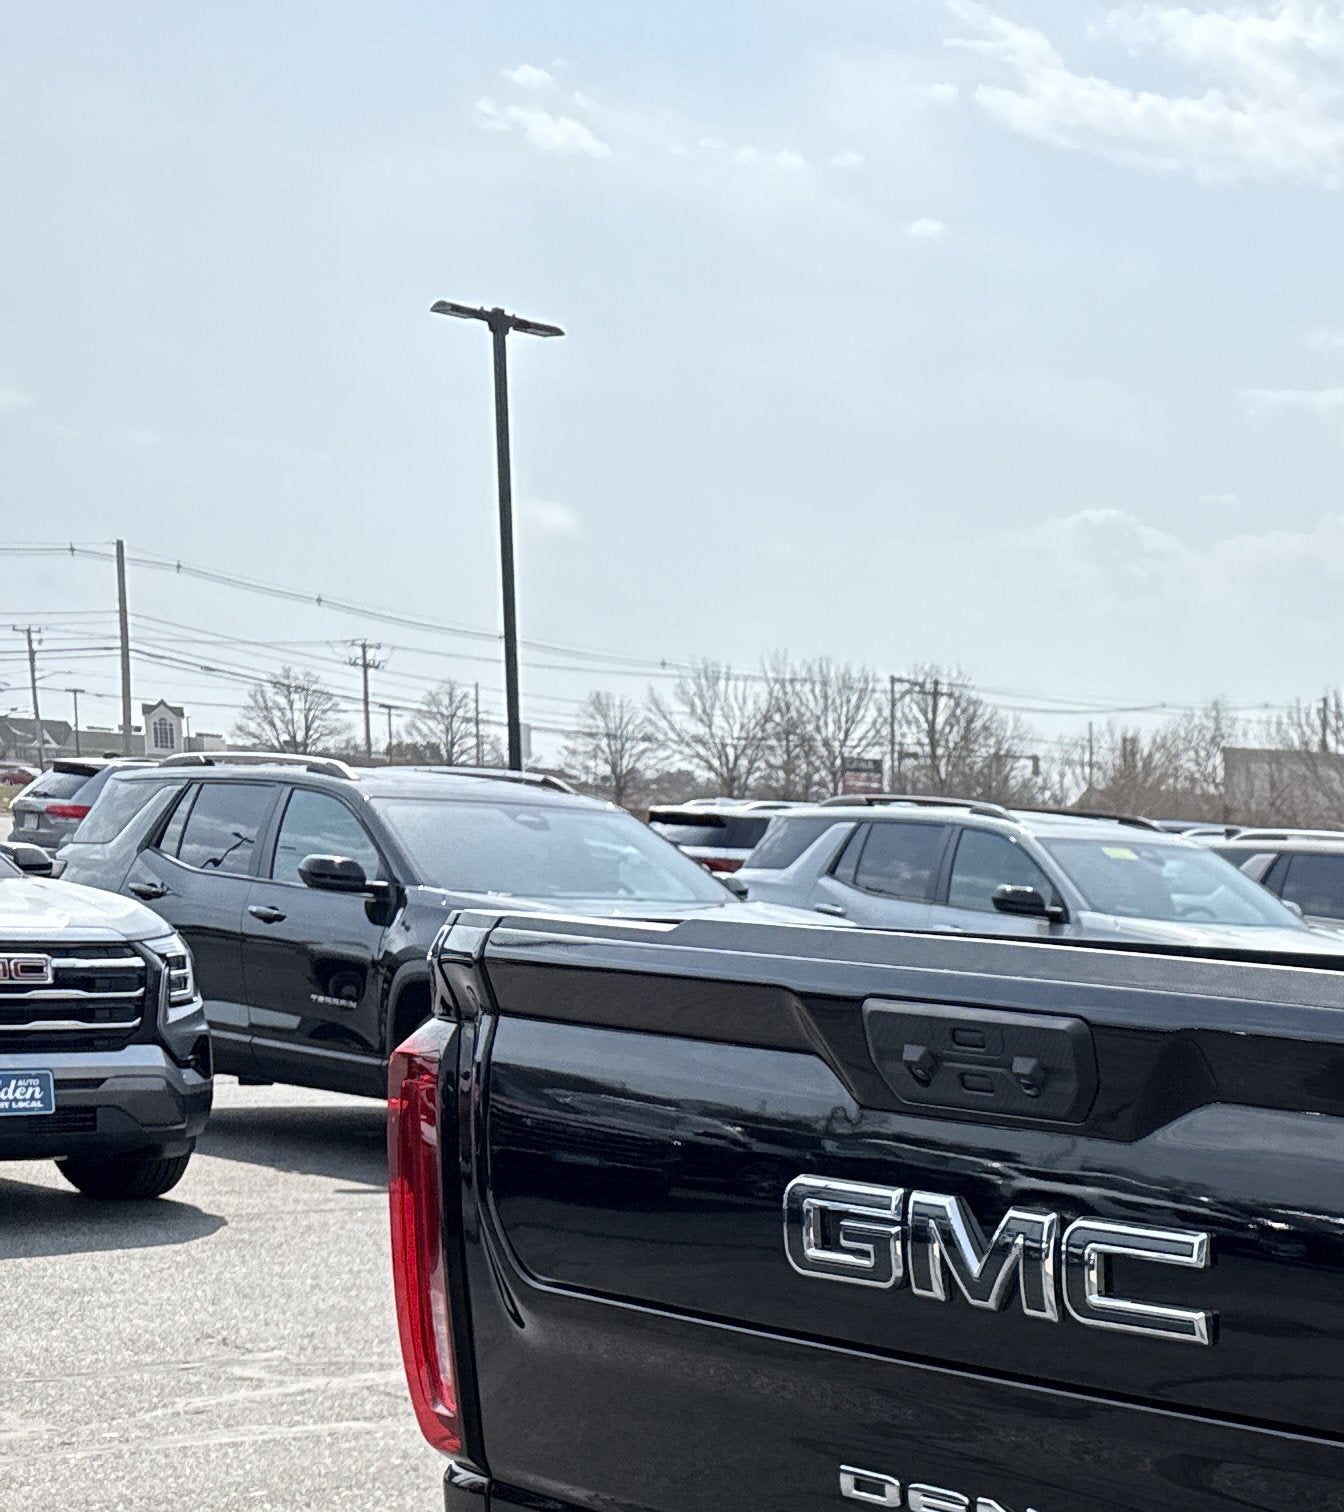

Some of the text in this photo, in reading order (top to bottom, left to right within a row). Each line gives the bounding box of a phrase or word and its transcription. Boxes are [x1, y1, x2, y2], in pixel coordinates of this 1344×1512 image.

[0, 958, 48, 980] C
[17, 1078, 40, 1087] AUTO
[783, 1174, 1216, 1346] GMC
